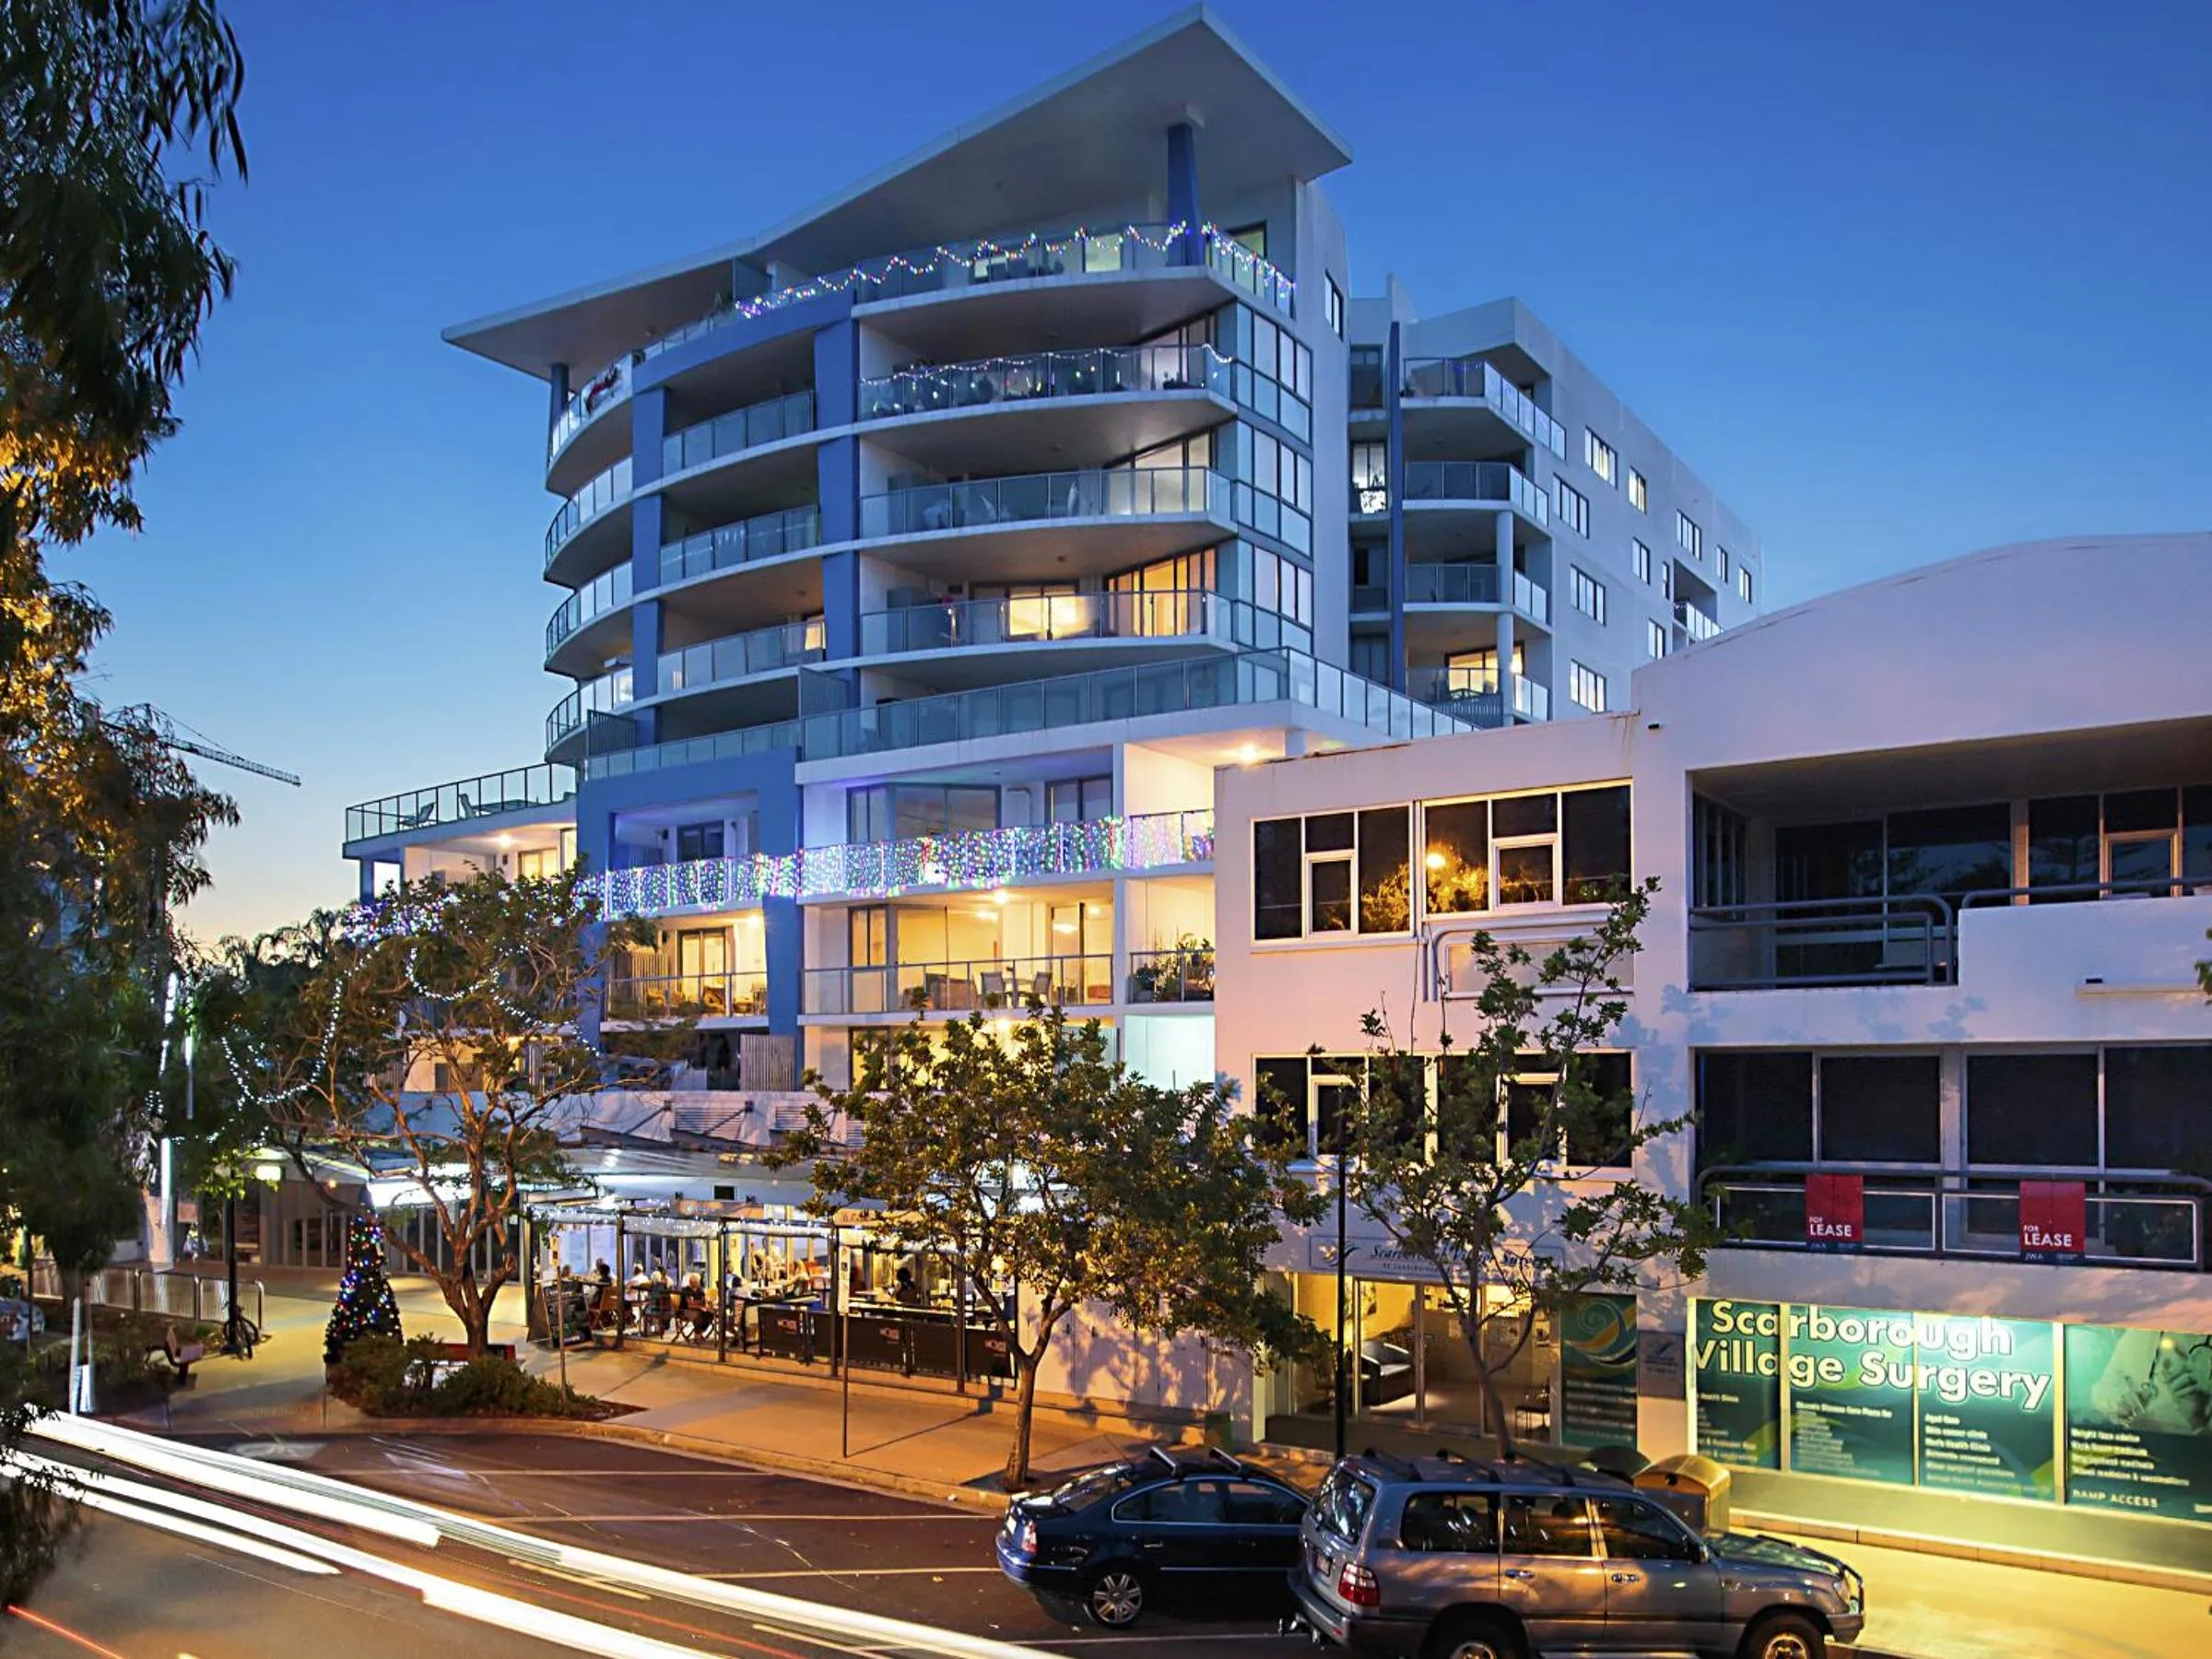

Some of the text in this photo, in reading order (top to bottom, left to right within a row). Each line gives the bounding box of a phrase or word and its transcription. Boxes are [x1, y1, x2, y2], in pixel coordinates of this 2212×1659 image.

[1810, 1224, 1852, 1236] LEASE
[2024, 1232, 2072, 1247] LEASE
[1712, 1300, 2012, 1361] Scarborough
[1696, 1339, 2052, 1410] Village Surgery
[2110, 1494, 2159, 1508] ACCESS
